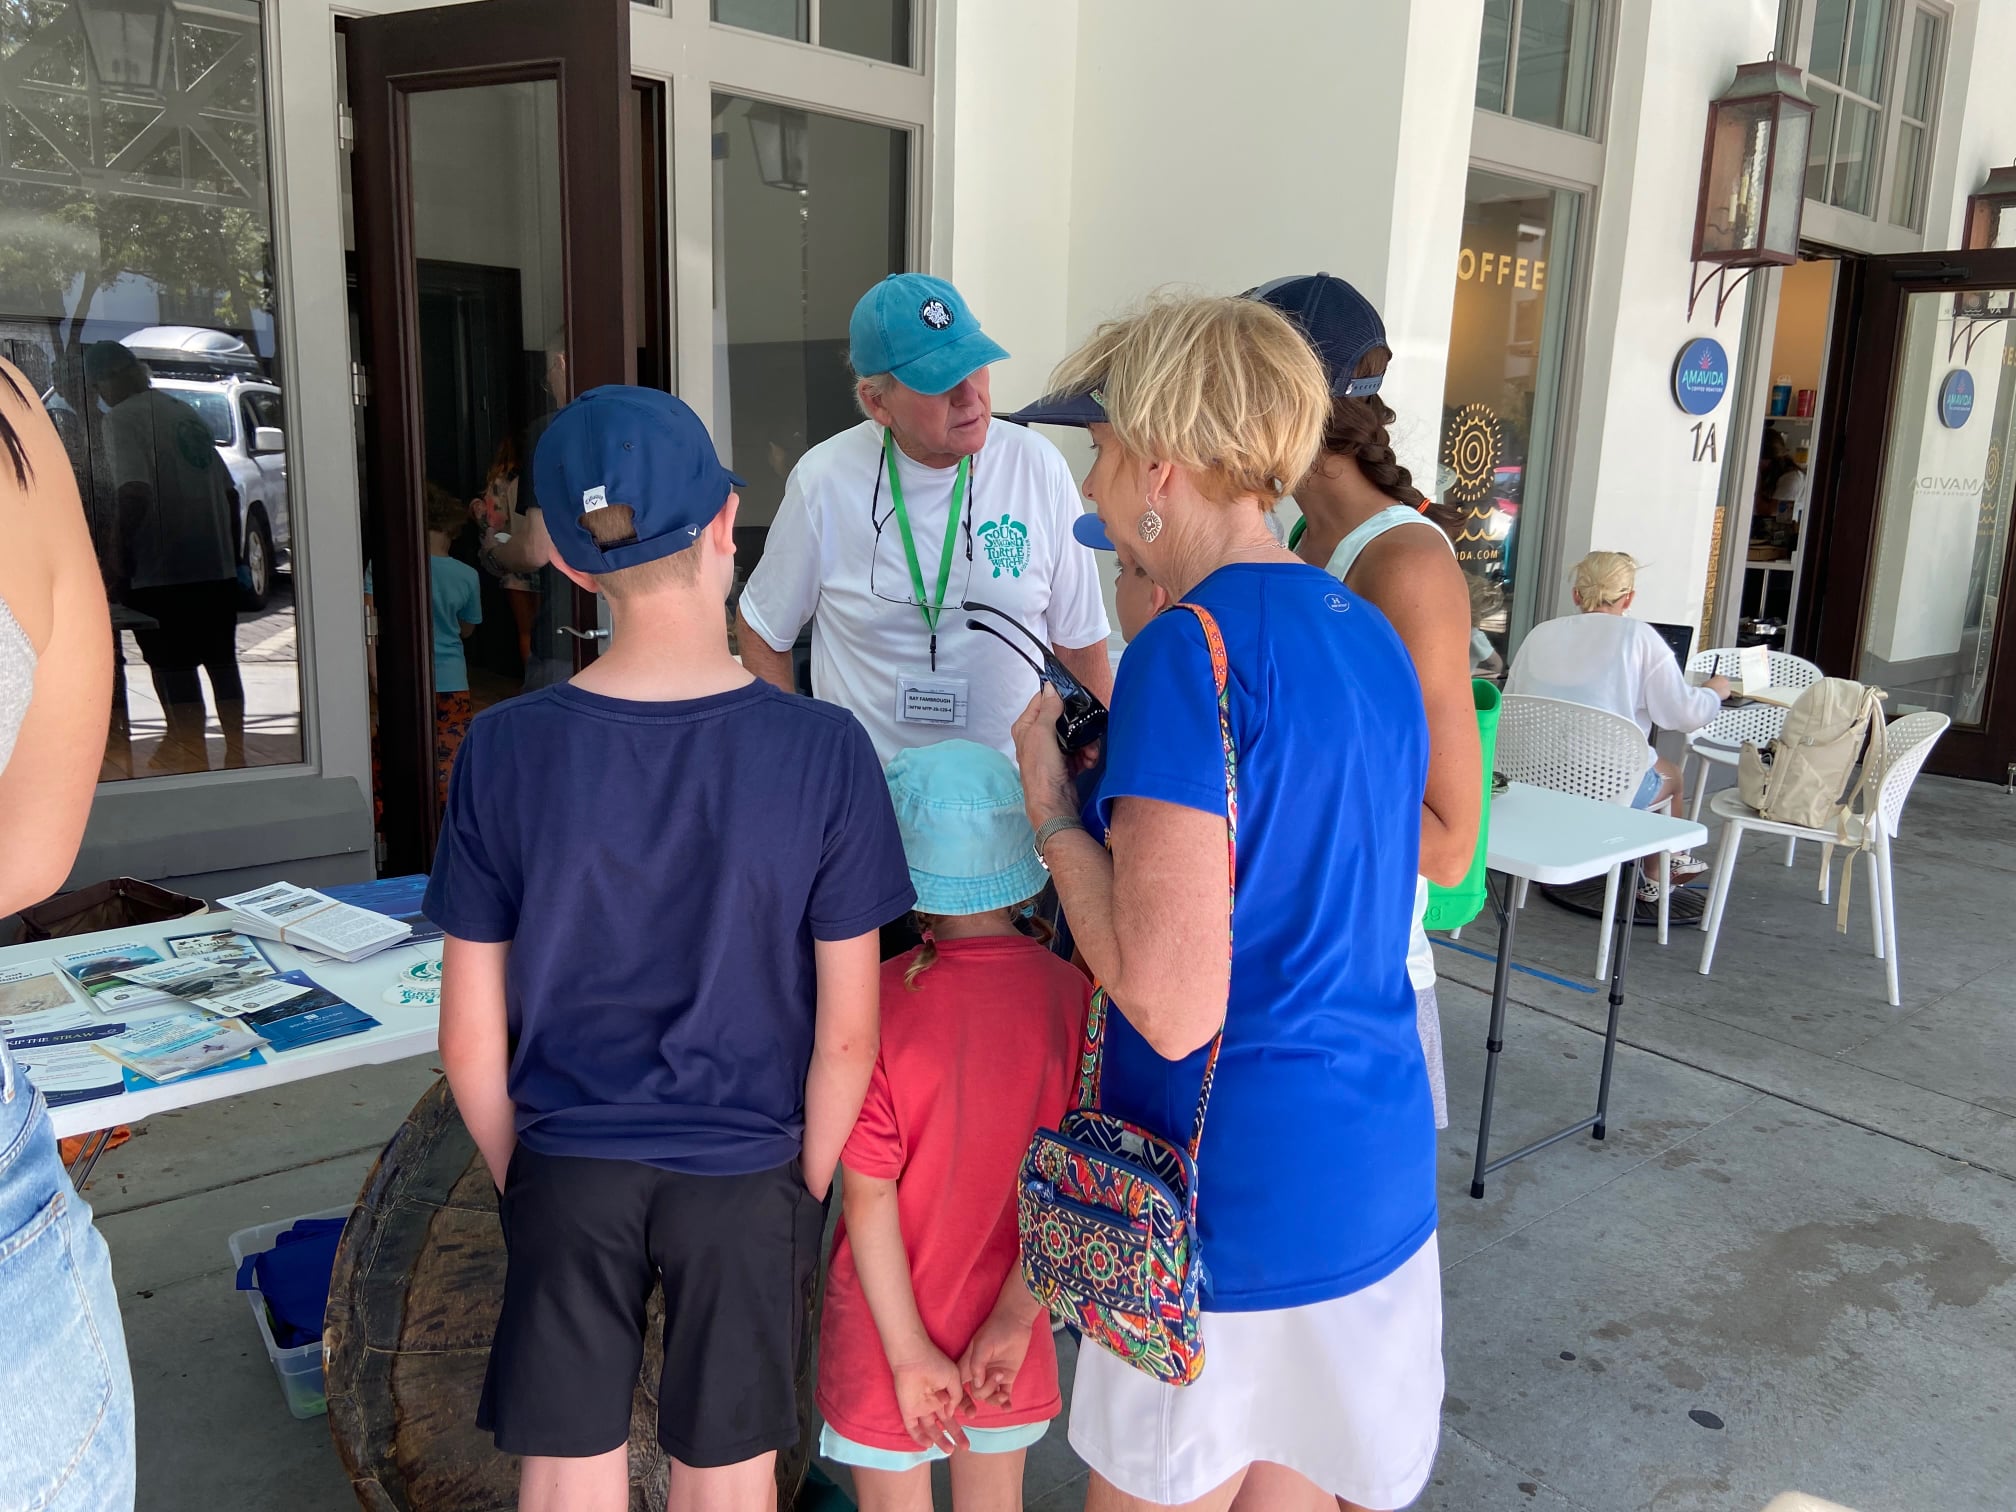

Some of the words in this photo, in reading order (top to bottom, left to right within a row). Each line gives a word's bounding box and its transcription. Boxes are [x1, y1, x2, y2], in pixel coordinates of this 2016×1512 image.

[1458, 248, 1545, 291] OFFEE
[1682, 369, 1724, 390] AMAVIDA
[1690, 421, 1717, 463] 1A
[984, 526, 1024, 547] SOUTH
[984, 547, 1024, 559] TURTLE
[1456, 549, 1498, 560] IDA.COM
[53, 1031, 96, 1042] STRAW
